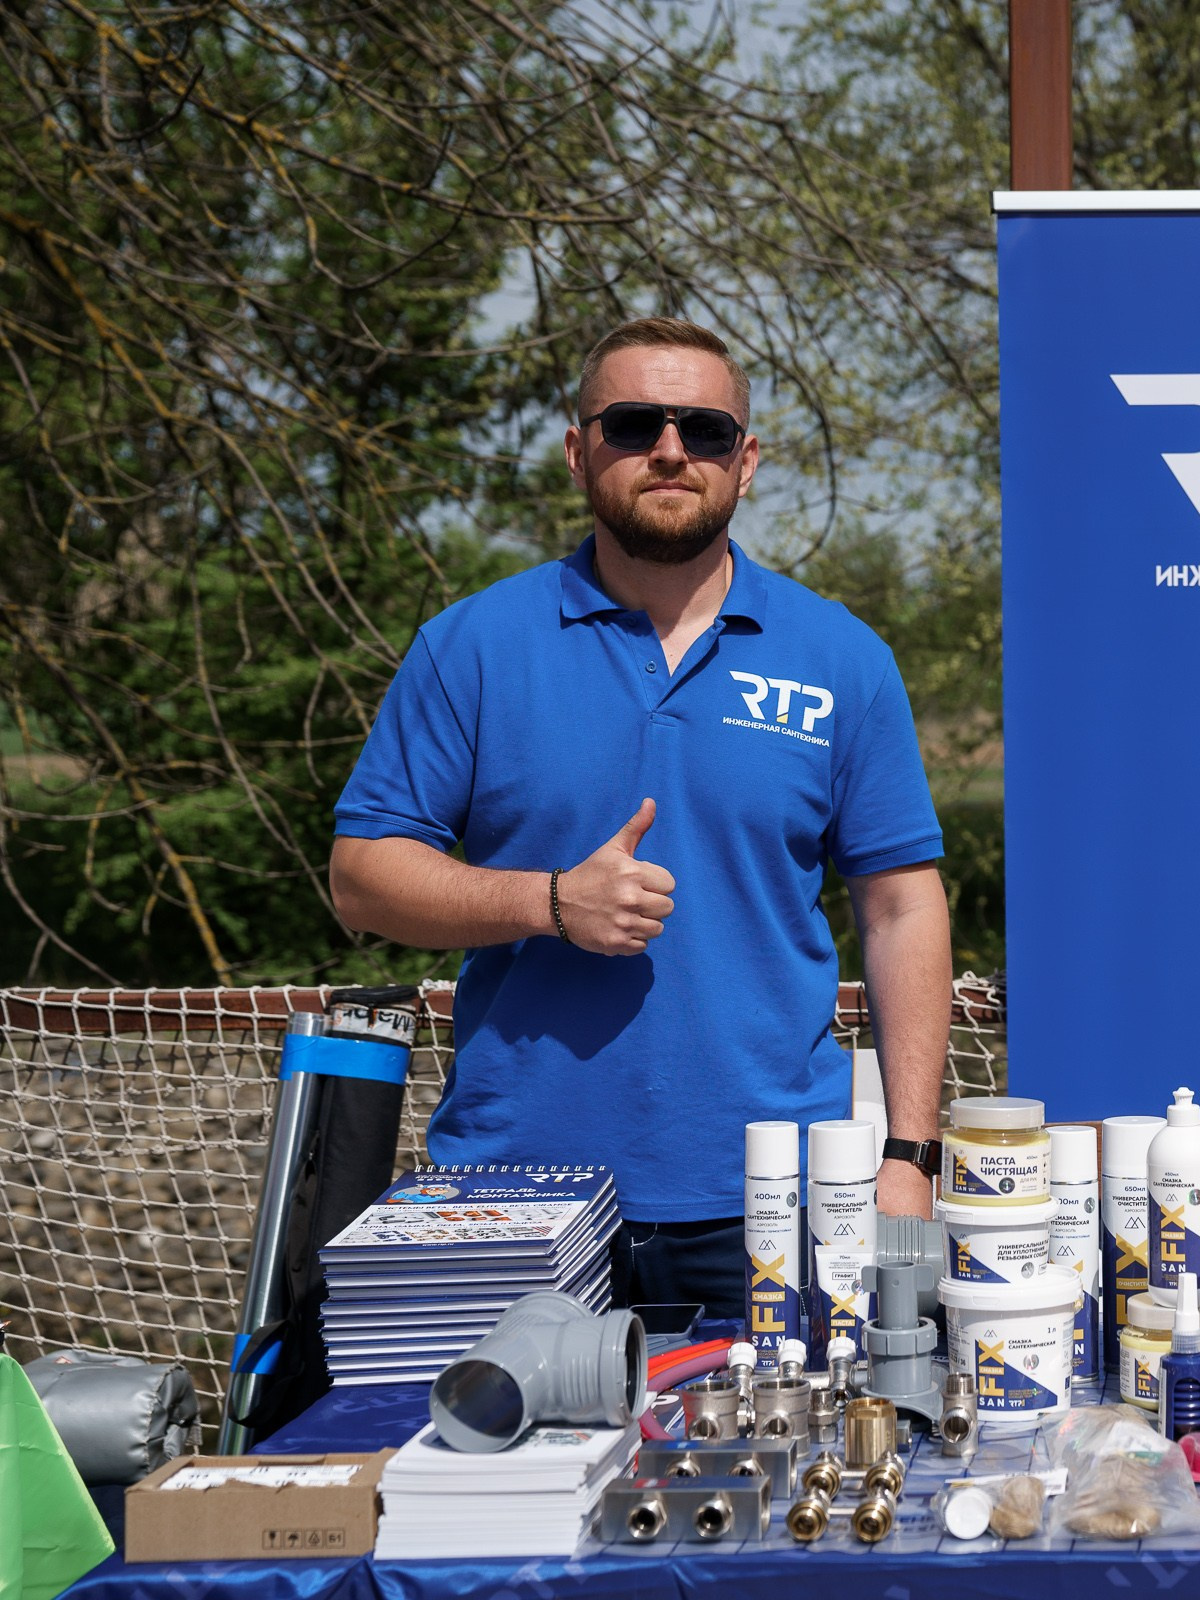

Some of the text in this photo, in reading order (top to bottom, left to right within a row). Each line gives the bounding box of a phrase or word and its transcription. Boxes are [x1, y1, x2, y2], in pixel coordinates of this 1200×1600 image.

[729, 671, 834, 732] RTP
[722, 716, 830, 748] ИНЖЕНЕРНАЯ САНТЕХНИКА
[980, 1157, 1016, 1166] ПАСТА
[955, 1155, 968, 1185] FIX
[980, 1166, 1038, 1176] ЧИСТЯЩАЯ
[525, 1173, 594, 1183] RTP
[466, 1191, 576, 1199] МОНТАЖНИКА
[821, 1200, 868, 1208] УНИВЕРСАЛЬНЫЙ
[1160, 1204, 1186, 1262] FIX
[1012, 1246, 1045, 1255] УПЛОТНЕНИЯ
[957, 1241, 971, 1273] FIX
[1161, 1264, 1186, 1272] SAN
[1008, 1341, 1056, 1350] САНТЕХНИЧЕСКАЯ
[978, 1339, 1004, 1396] FIX
[1138, 1360, 1151, 1391] FIX
[979, 1397, 1005, 1408] SAN
